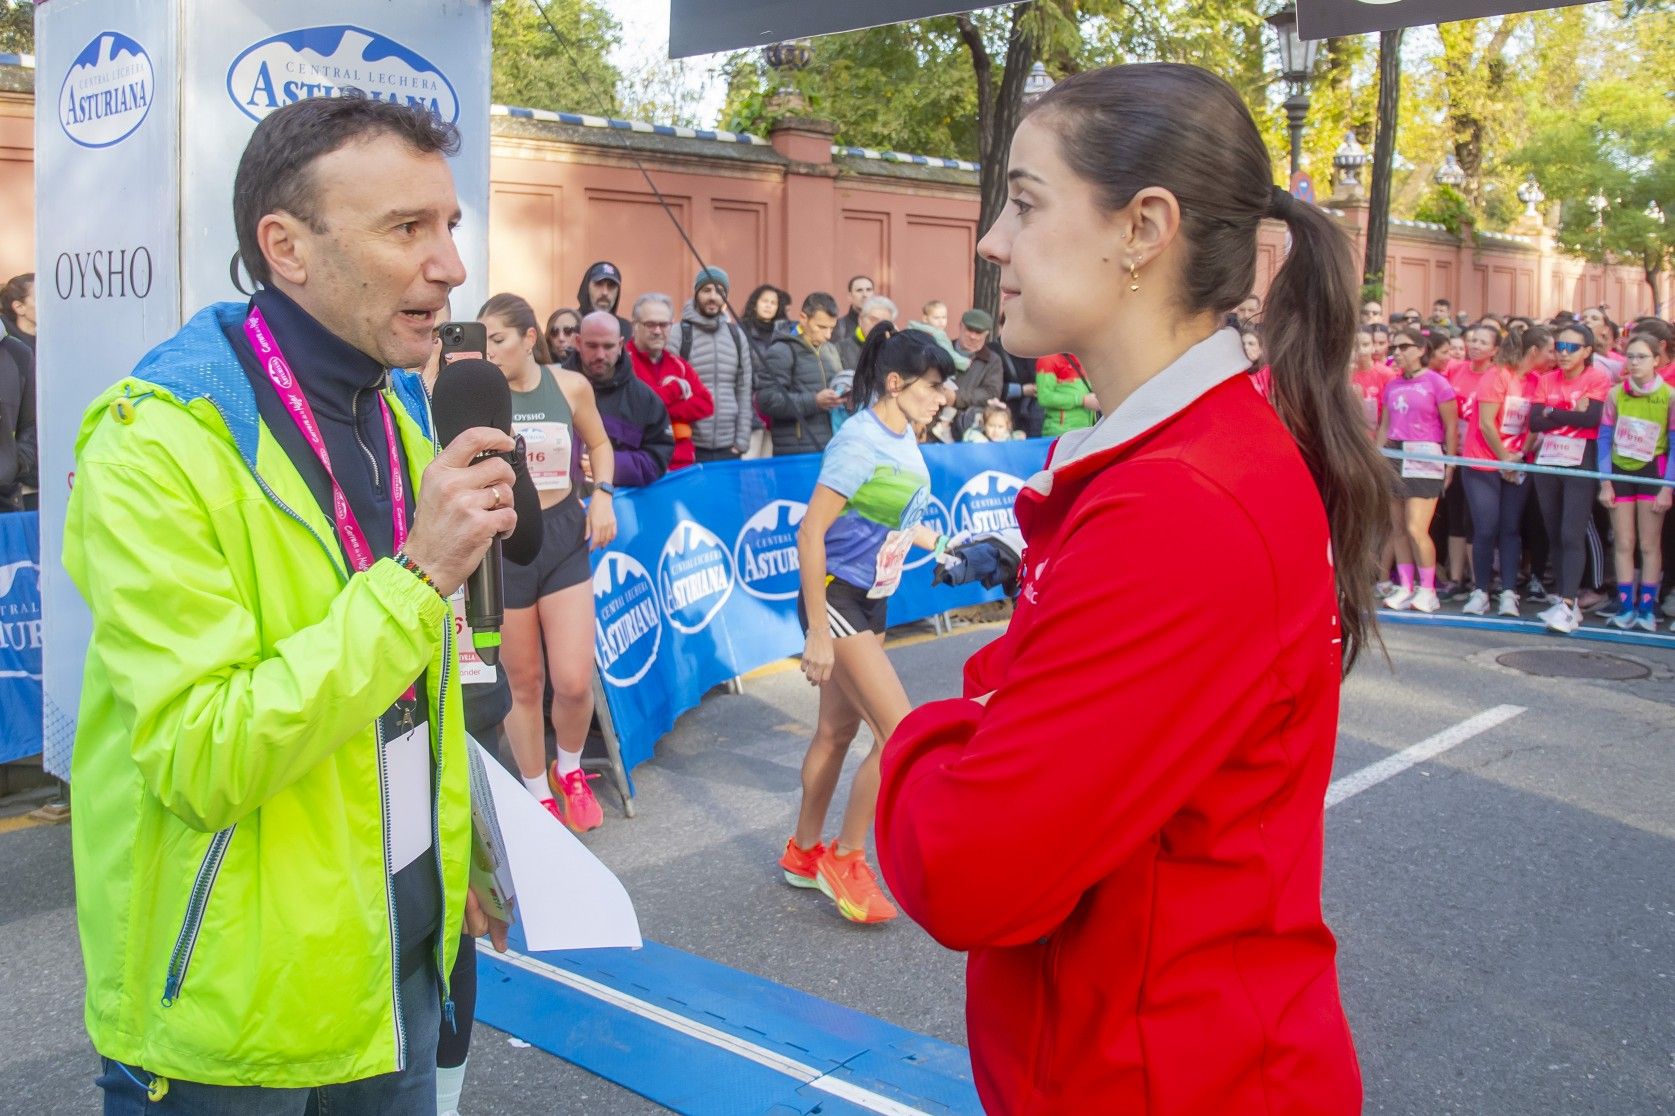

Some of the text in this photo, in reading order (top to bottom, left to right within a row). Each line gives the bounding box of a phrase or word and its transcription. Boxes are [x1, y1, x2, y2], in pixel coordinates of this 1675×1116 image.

[286, 61, 437, 91] CENTRAL LECHERA
[66, 79, 147, 126] ASTURIANA
[55, 246, 153, 300] OYSHO
[514, 412, 546, 421] OYSHO
[757, 533, 794, 549] CENTRAL
[595, 597, 659, 670] ASTURIANA
